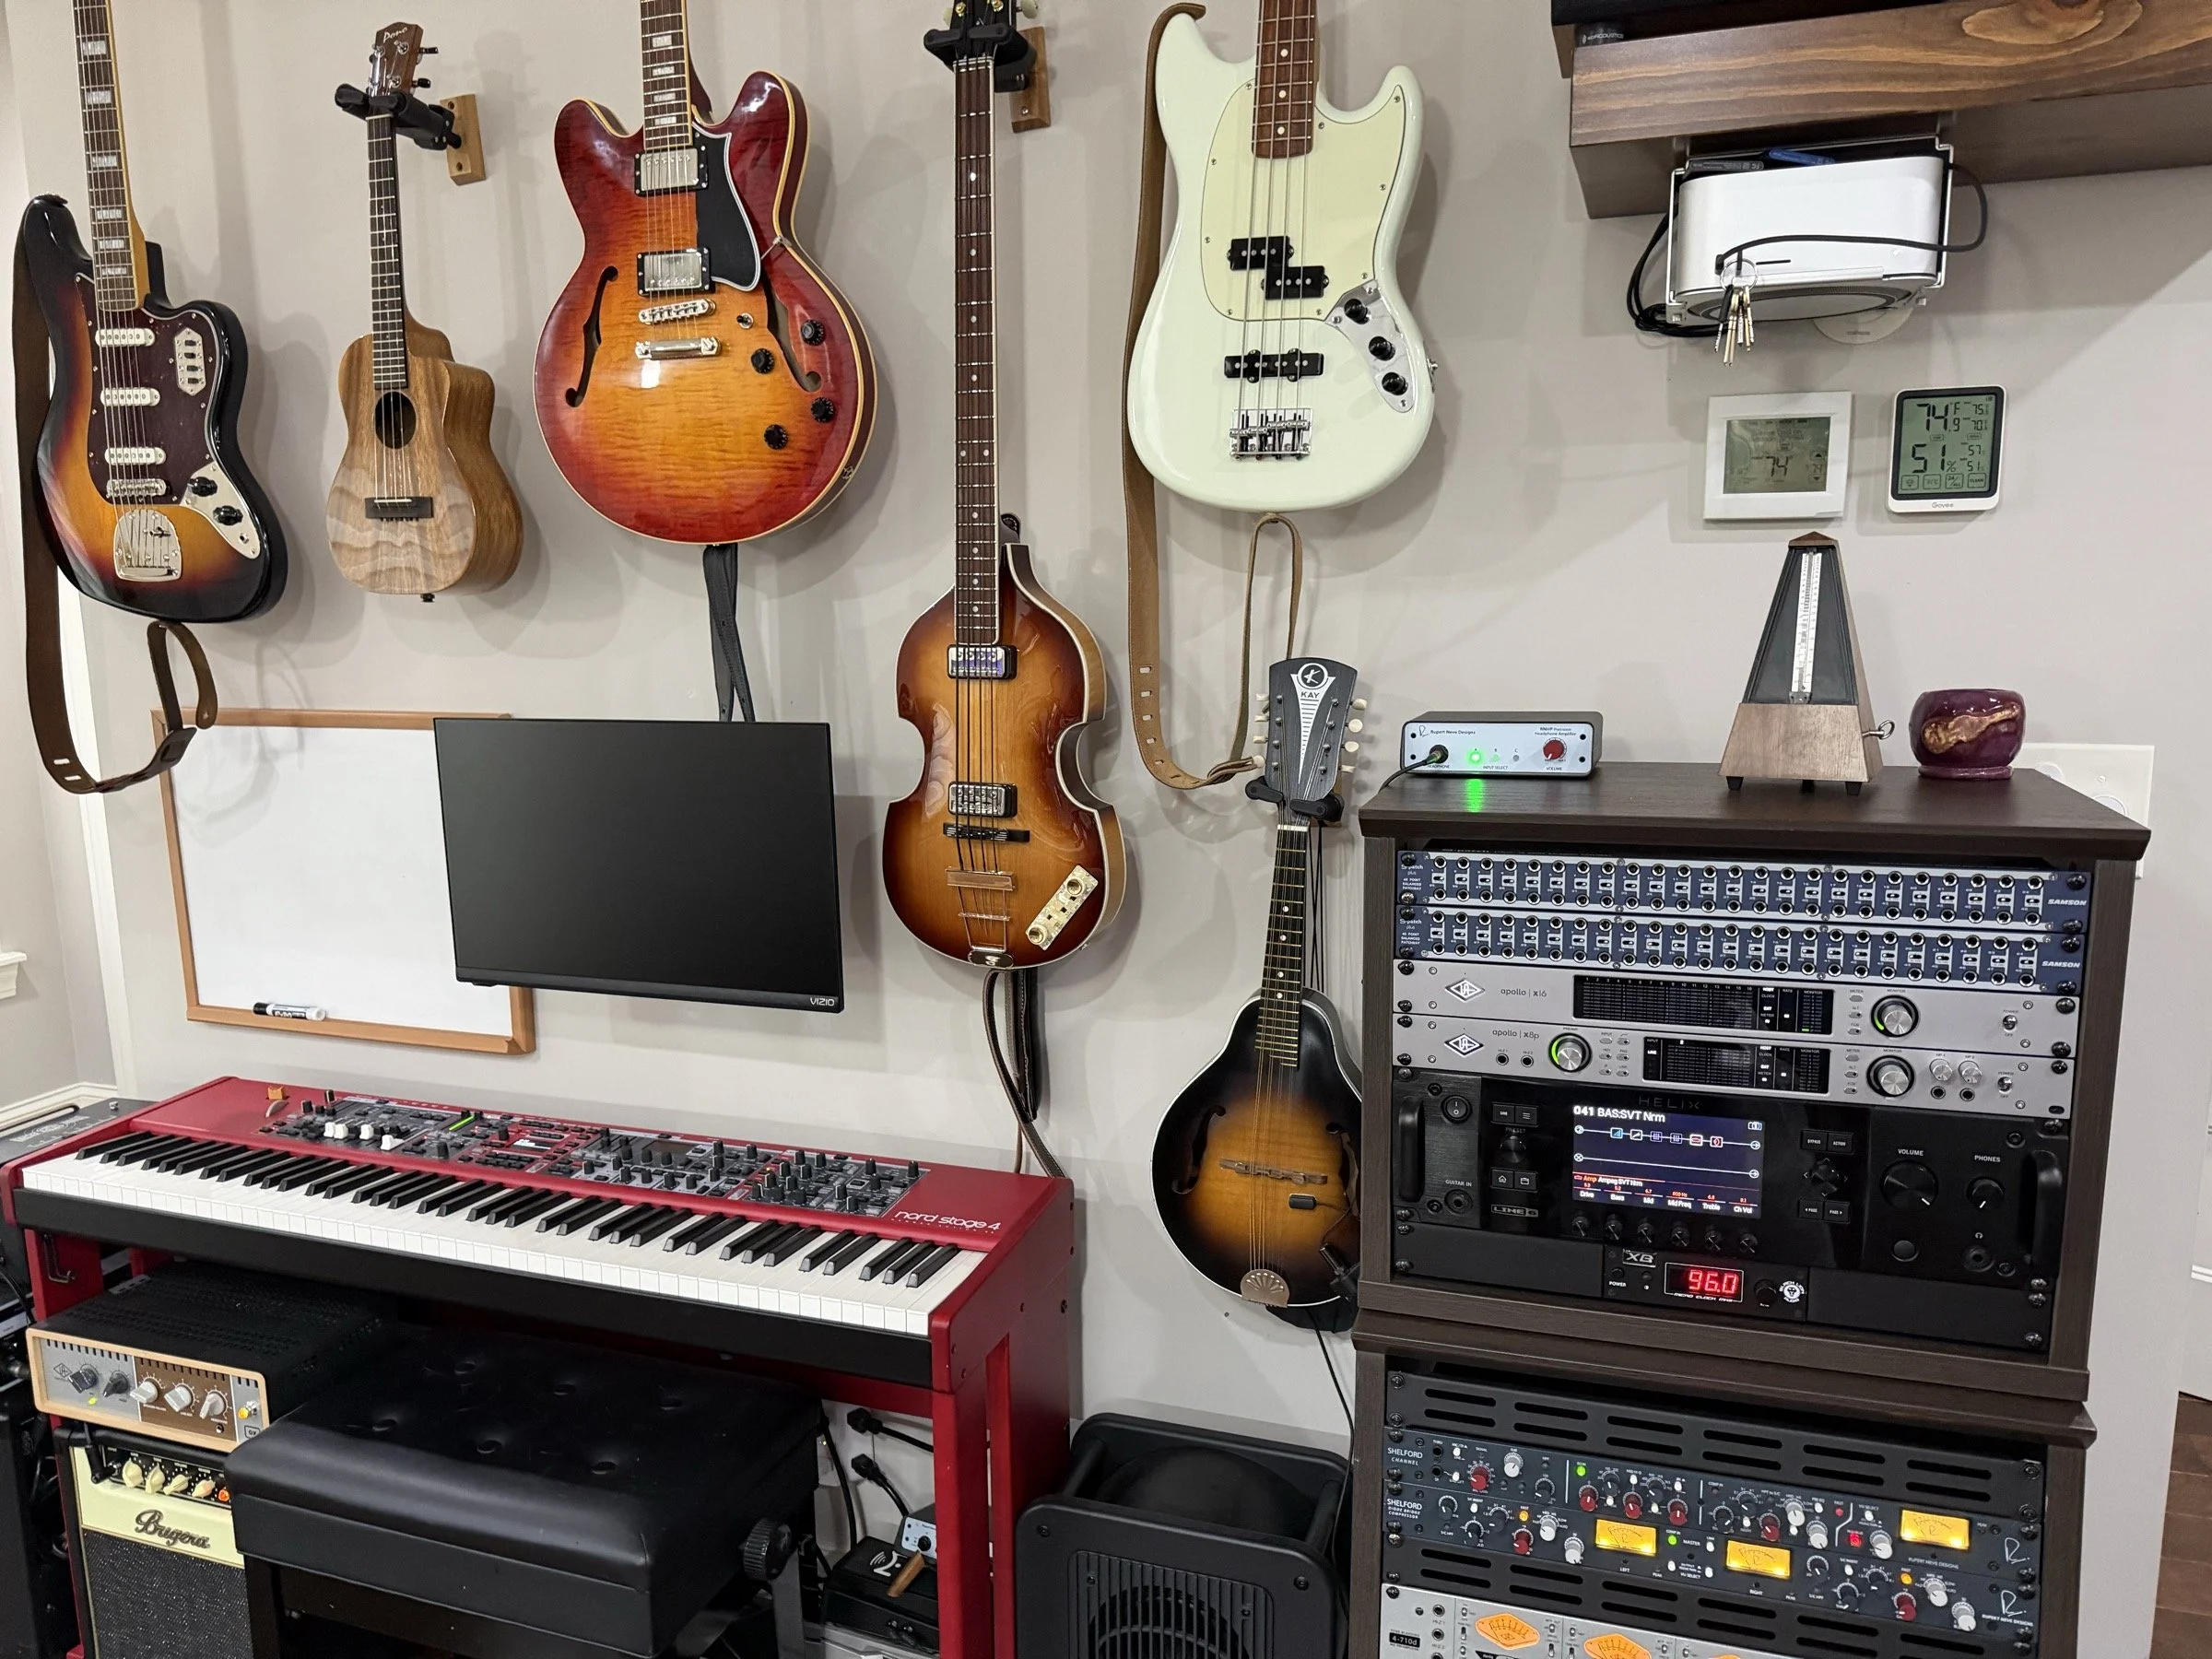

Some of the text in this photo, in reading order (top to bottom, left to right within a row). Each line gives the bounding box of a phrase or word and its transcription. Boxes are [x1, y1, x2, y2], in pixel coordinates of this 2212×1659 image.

[1500, 988, 1547, 997] apollo x16
[810, 997, 835, 1006] VIZIO
[1492, 1029, 1540, 1041] apollo x8p
[1639, 1096, 1700, 1110] HELIX
[1643, 1112, 1665, 1123] Nrm
[1898, 1148, 1924, 1157] VOLUME
[1974, 1155, 2001, 1163] PHONES
[1583, 1175, 1597, 1183] Amp
[1580, 1191, 1594, 1199] Drive
[1677, 1201, 1692, 1209] Freq
[1702, 1203, 1721, 1211] Treble
[1493, 1206, 1525, 1215] LINE
[894, 1211, 938, 1222] nord
[938, 1216, 987, 1228] stage
[987, 1222, 1001, 1230] 4
[1688, 1269, 1738, 1295] 96.0
[1387, 1447, 1423, 1459] SHELFORD
[1391, 1457, 1418, 1466] CHANNEL
[1386, 1498, 1422, 1511] SHELFORD
[135, 1509, 210, 1548] Bugera
[1908, 1557, 1924, 1565] RUPERT
[1938, 1561, 1959, 1570] DESIGNS
[1982, 1614, 2000, 1622] RUPERT
[2013, 1618, 2033, 1627] DESIGNS
[1392, 1637, 1418, 1646] 4-710d
